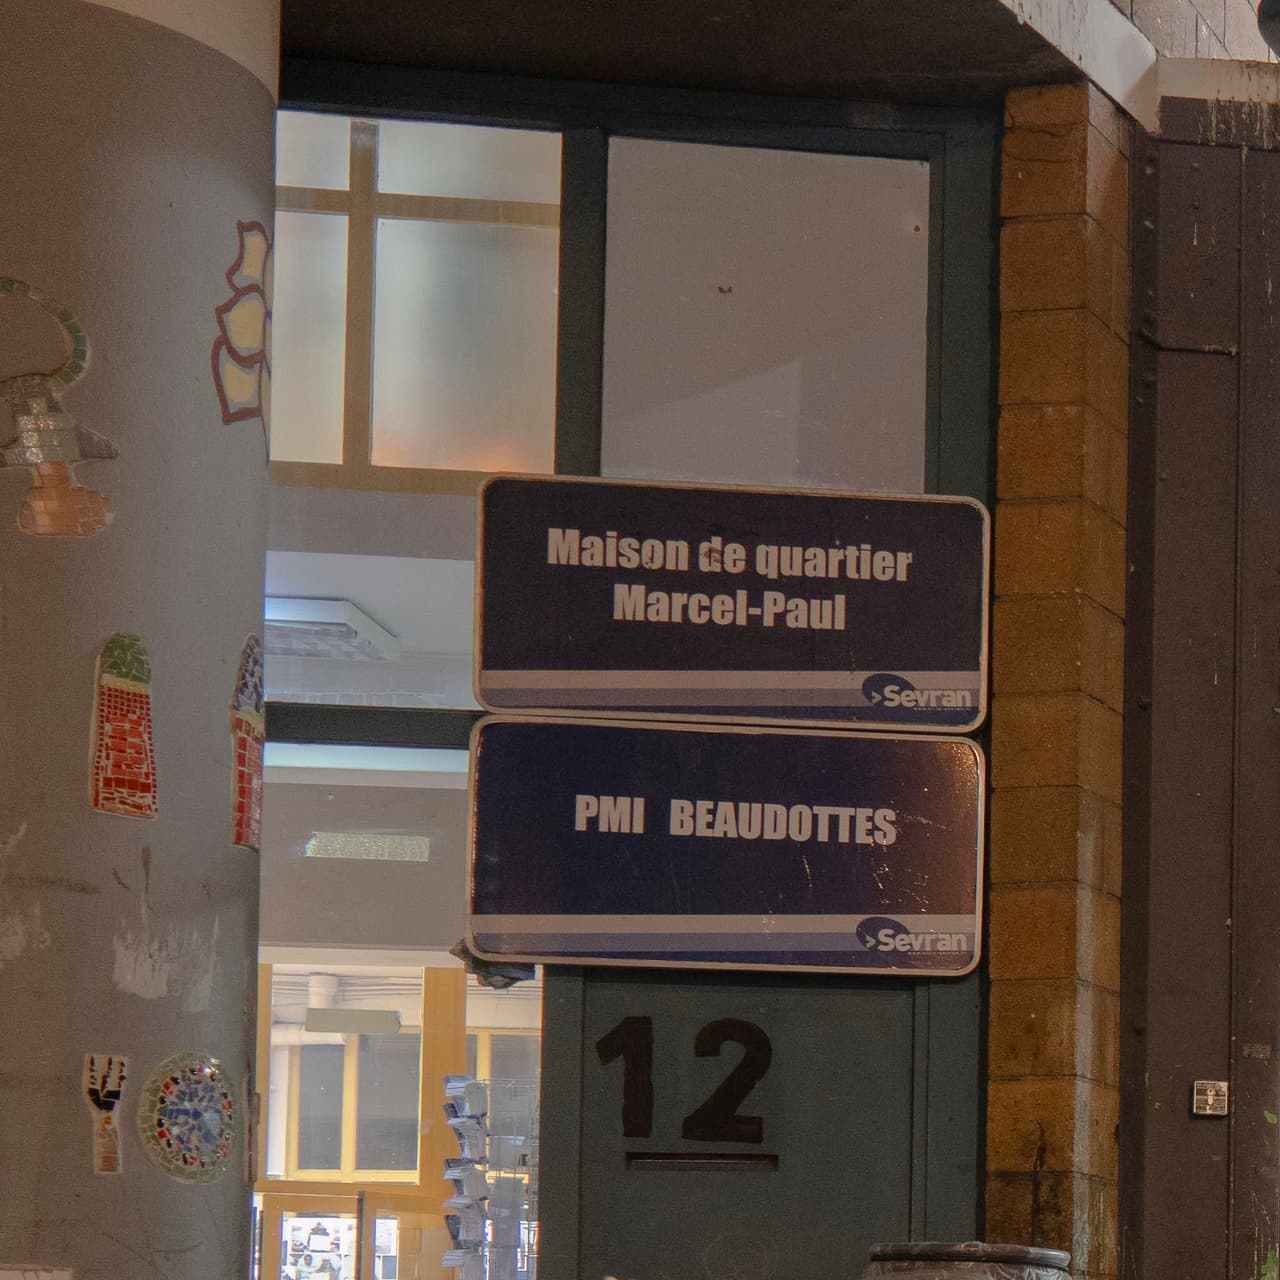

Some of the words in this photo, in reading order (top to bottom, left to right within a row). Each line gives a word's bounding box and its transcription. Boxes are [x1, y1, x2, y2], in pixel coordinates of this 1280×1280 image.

[548, 528, 688, 571] Maison
[699, 536, 746, 574] de
[755, 545, 912, 582] quartier
[613, 583, 846, 630] Marcel-Paul
[884, 685, 971, 707] Sevran
[575, 794, 645, 834] PMI
[669, 799, 897, 846] BEAUDOTTES
[877, 929, 968, 952] Sevran
[596, 1016, 772, 1143] 12
